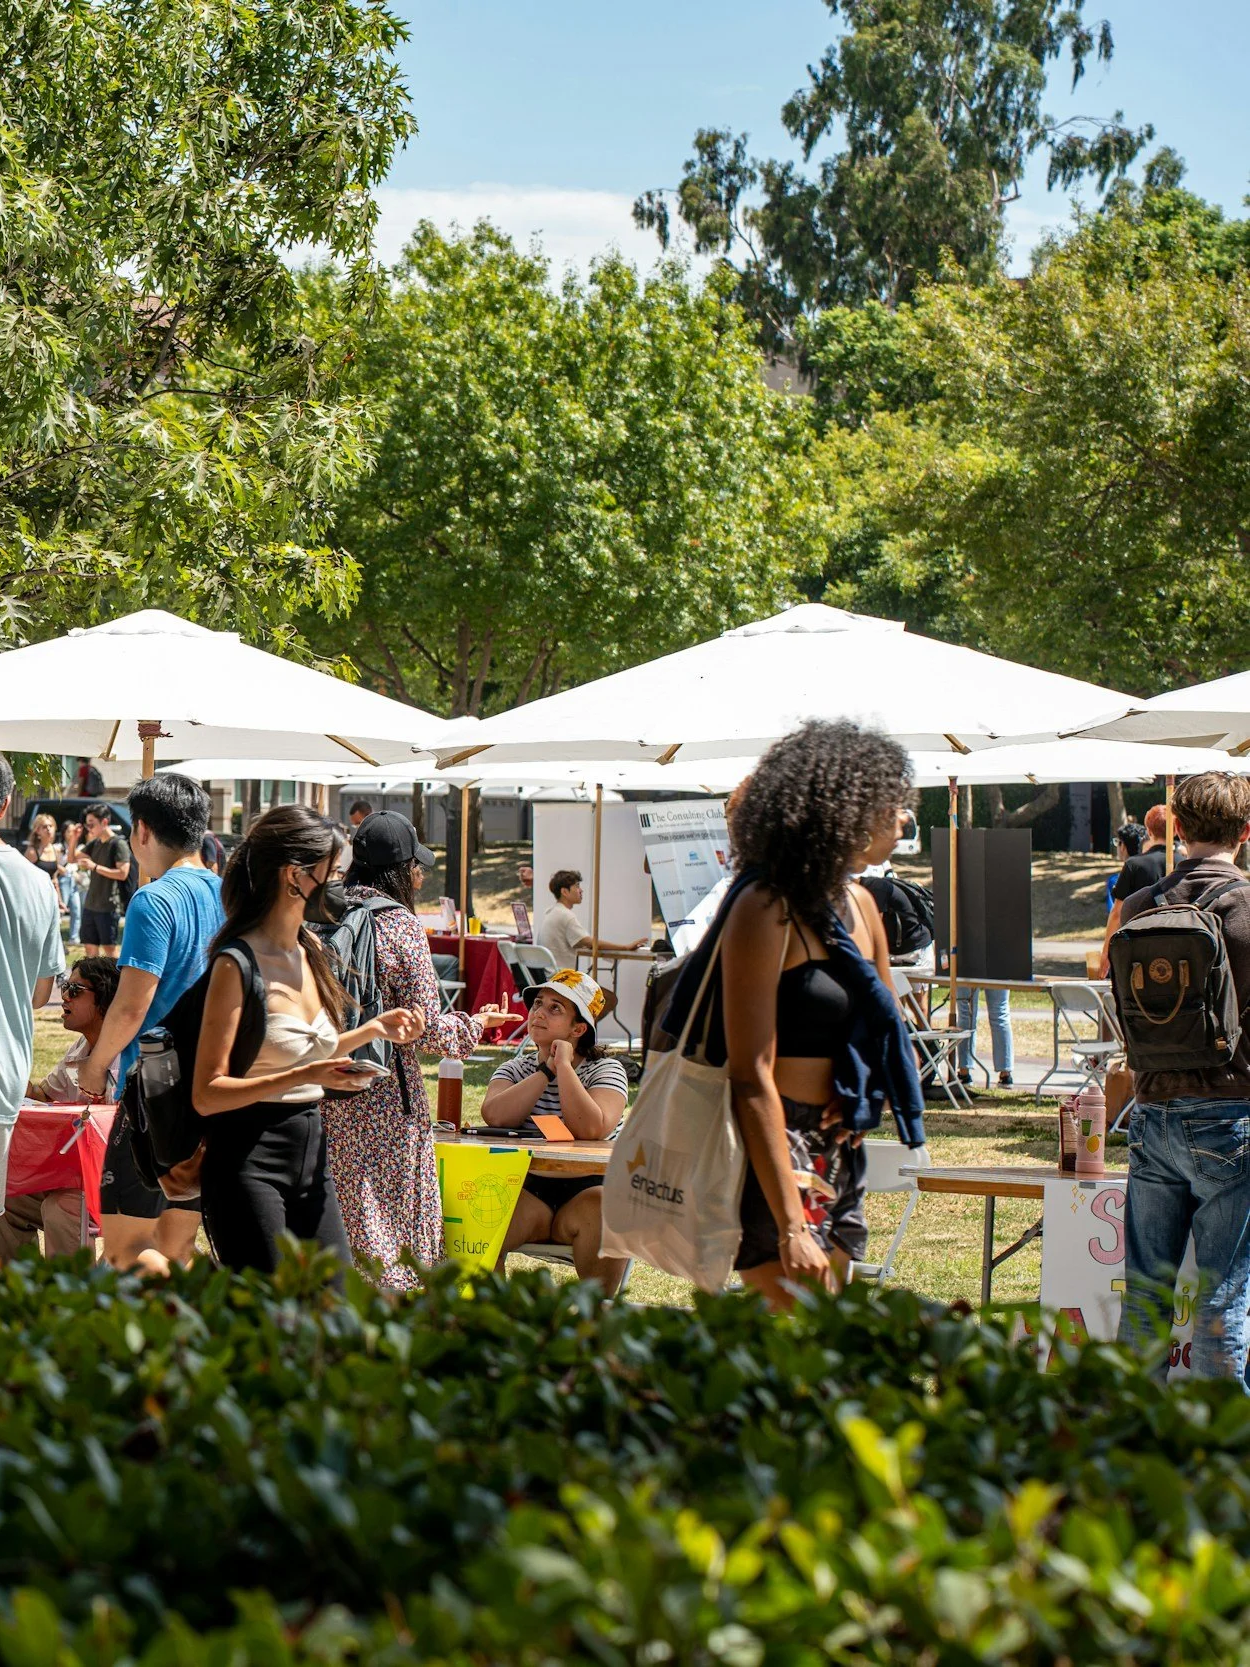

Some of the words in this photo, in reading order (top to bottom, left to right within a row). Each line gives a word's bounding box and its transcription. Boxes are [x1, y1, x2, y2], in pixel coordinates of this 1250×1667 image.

[650, 812, 666, 823] The
[666, 809, 705, 821] Consulting
[706, 807, 724, 819] Club
[631, 1174, 684, 1204] enactus
